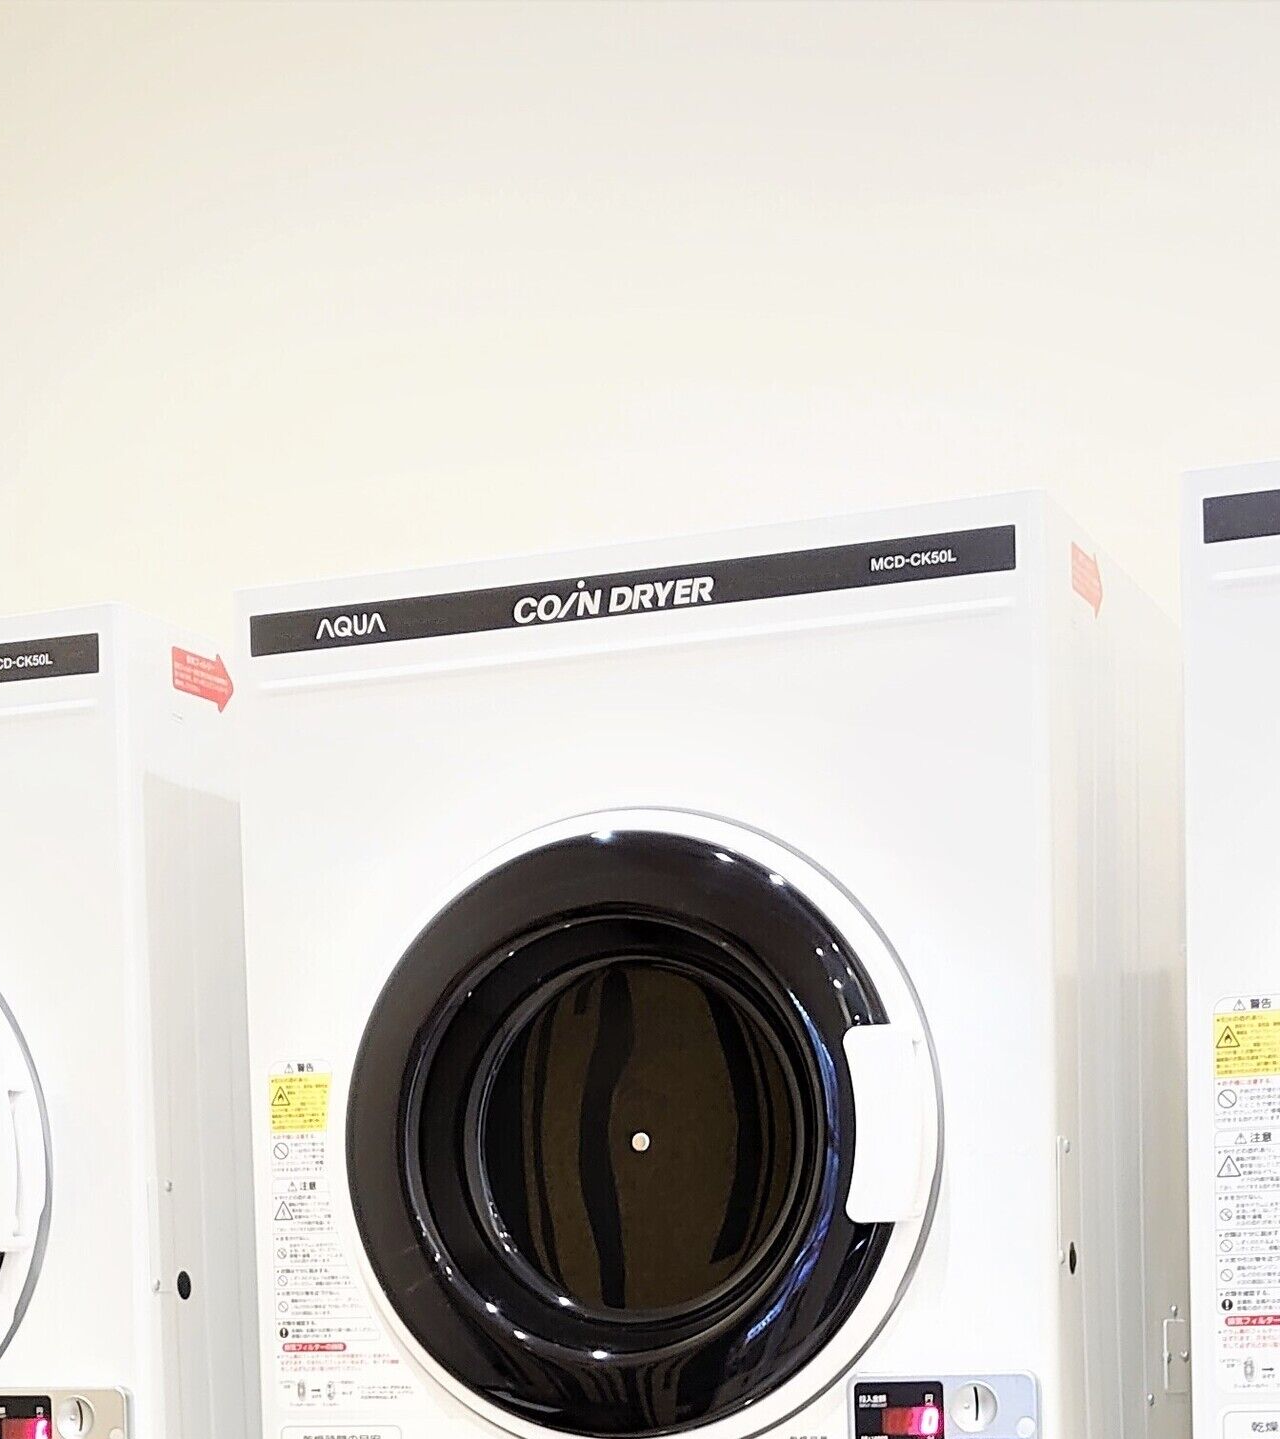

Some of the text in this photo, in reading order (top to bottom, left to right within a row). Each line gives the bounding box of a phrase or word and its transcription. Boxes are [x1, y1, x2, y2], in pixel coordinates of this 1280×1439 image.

[870, 550, 956, 572] MCD-CK50L
[513, 576, 714, 624] COIN DRYER
[316, 611, 385, 639] AQUA
